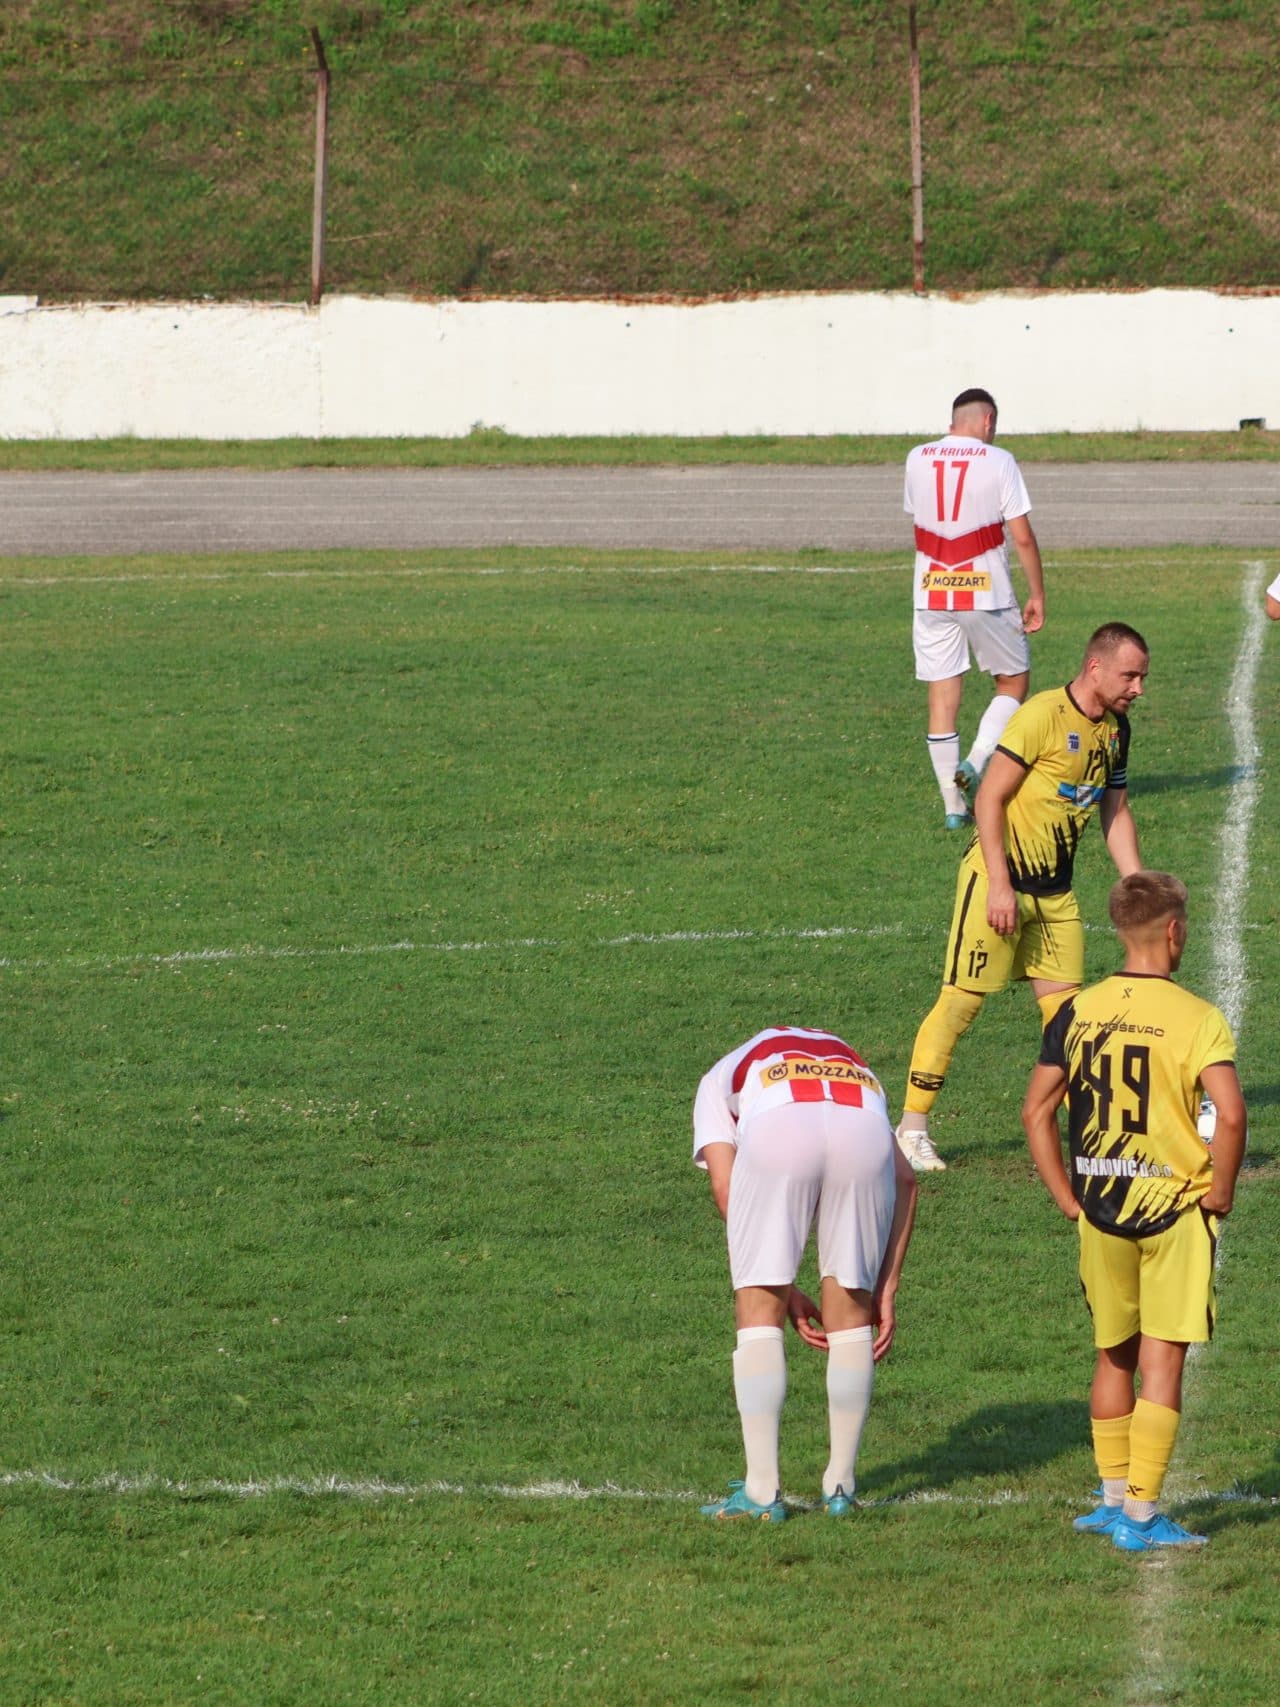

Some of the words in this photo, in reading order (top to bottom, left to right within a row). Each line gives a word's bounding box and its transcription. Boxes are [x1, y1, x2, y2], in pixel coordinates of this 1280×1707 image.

[921, 447, 938, 457] NK
[940, 447, 987, 457] KRIVAJA
[932, 460, 969, 522] 17
[932, 576, 987, 587] MOZZART
[795, 1063, 876, 1087] MOZZART
[1081, 1040, 1151, 1136] 49
